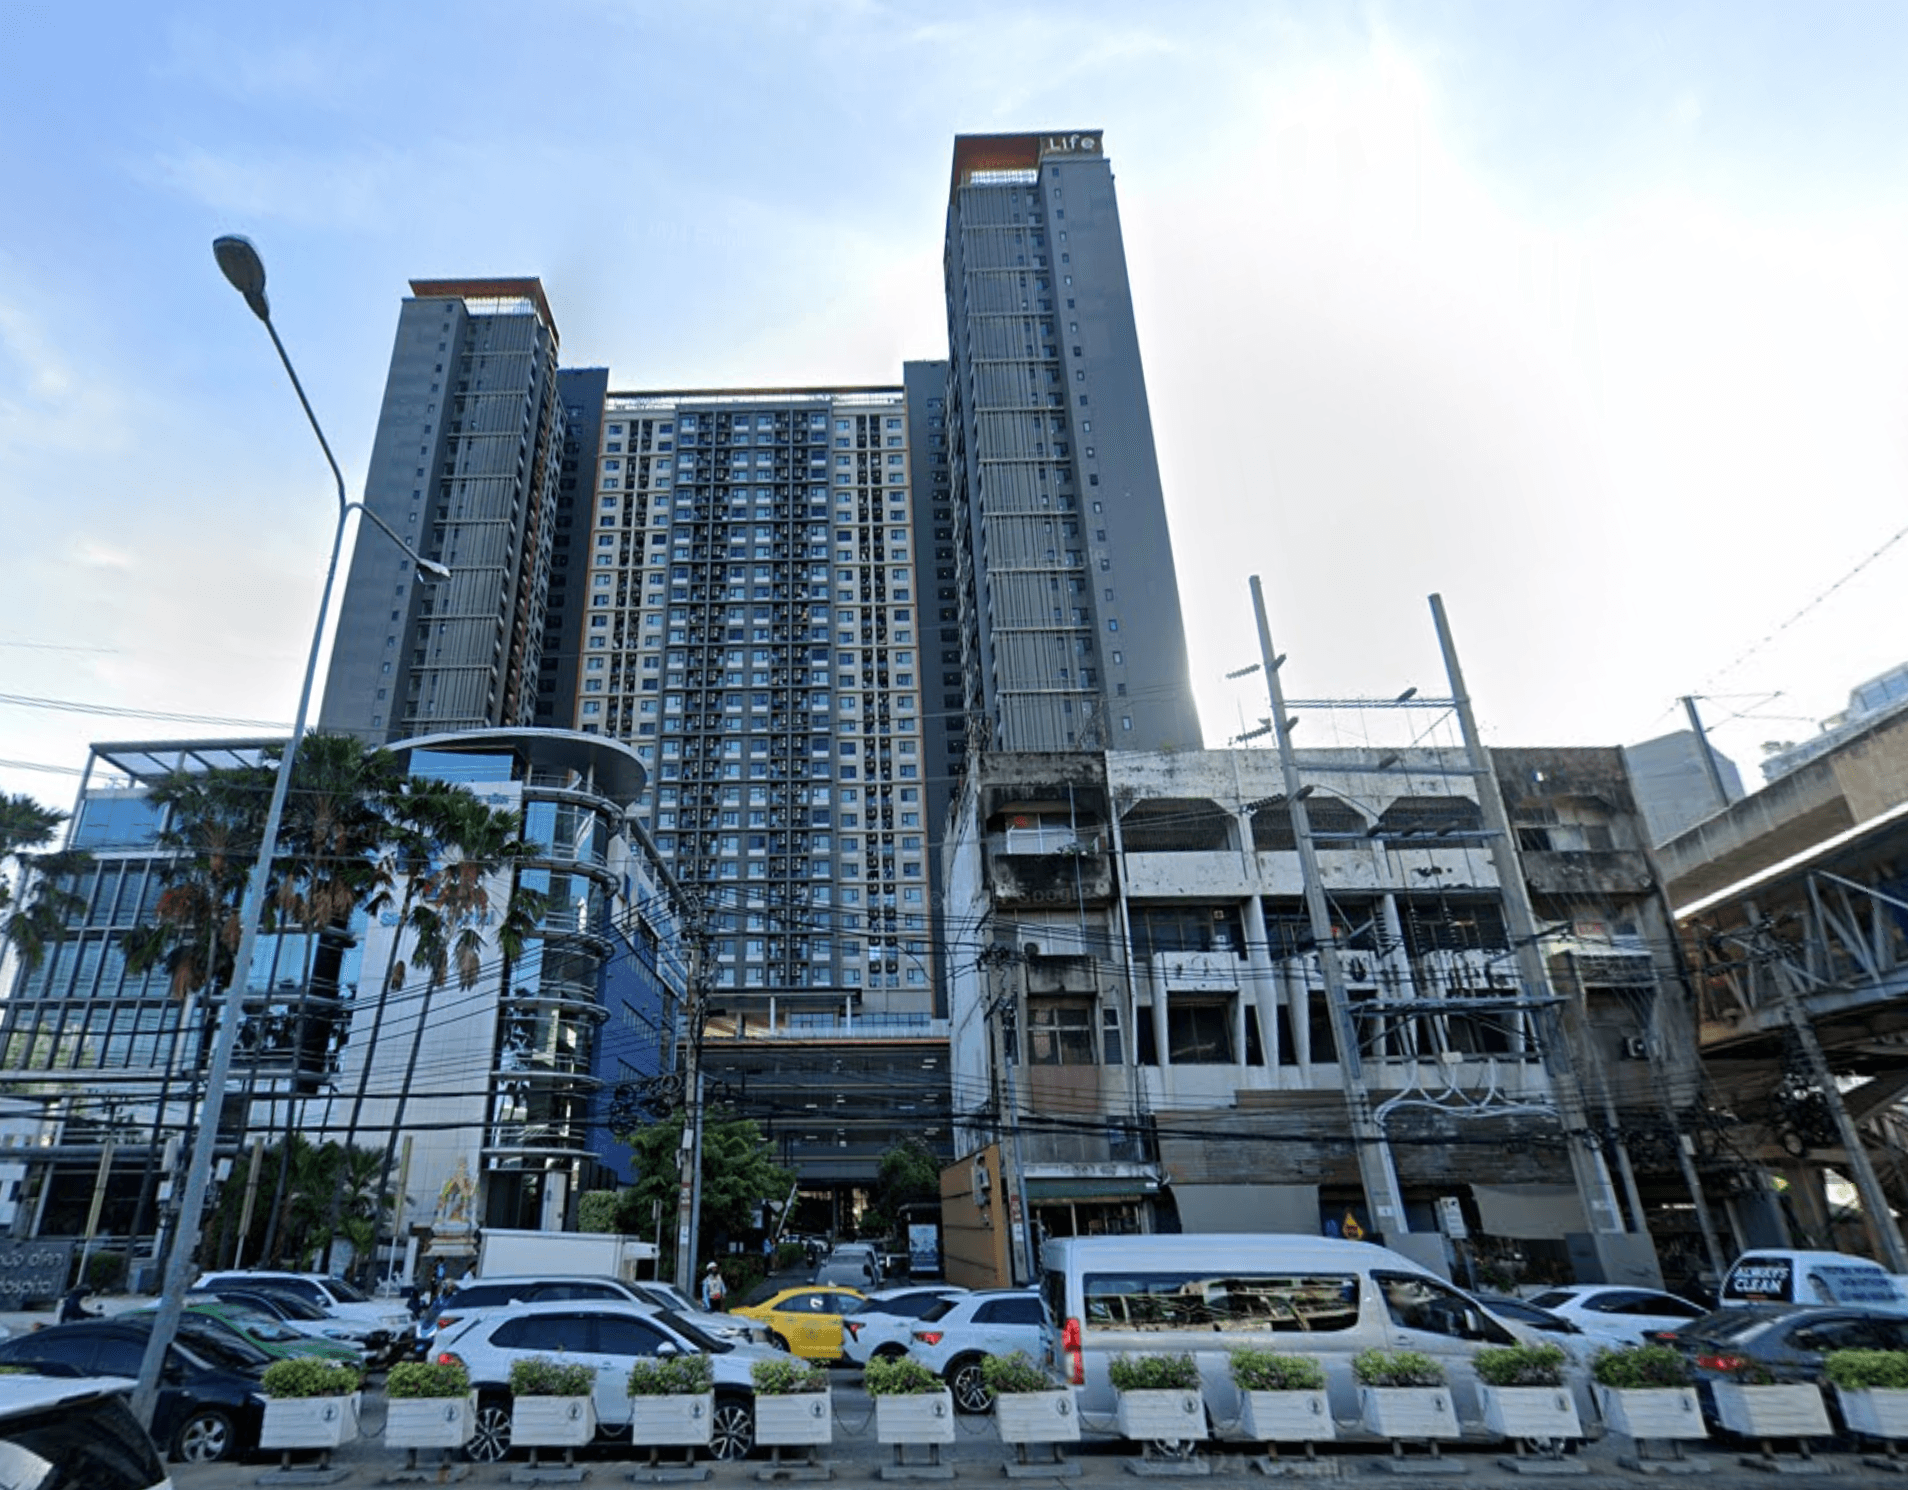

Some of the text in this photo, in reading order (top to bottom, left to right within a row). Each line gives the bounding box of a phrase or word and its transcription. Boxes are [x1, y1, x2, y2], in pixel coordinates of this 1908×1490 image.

[1050, 135, 1095, 150] Life
[1734, 1266, 1789, 1279] ALWAYS
[1734, 1279, 1782, 1294] CLEAN
